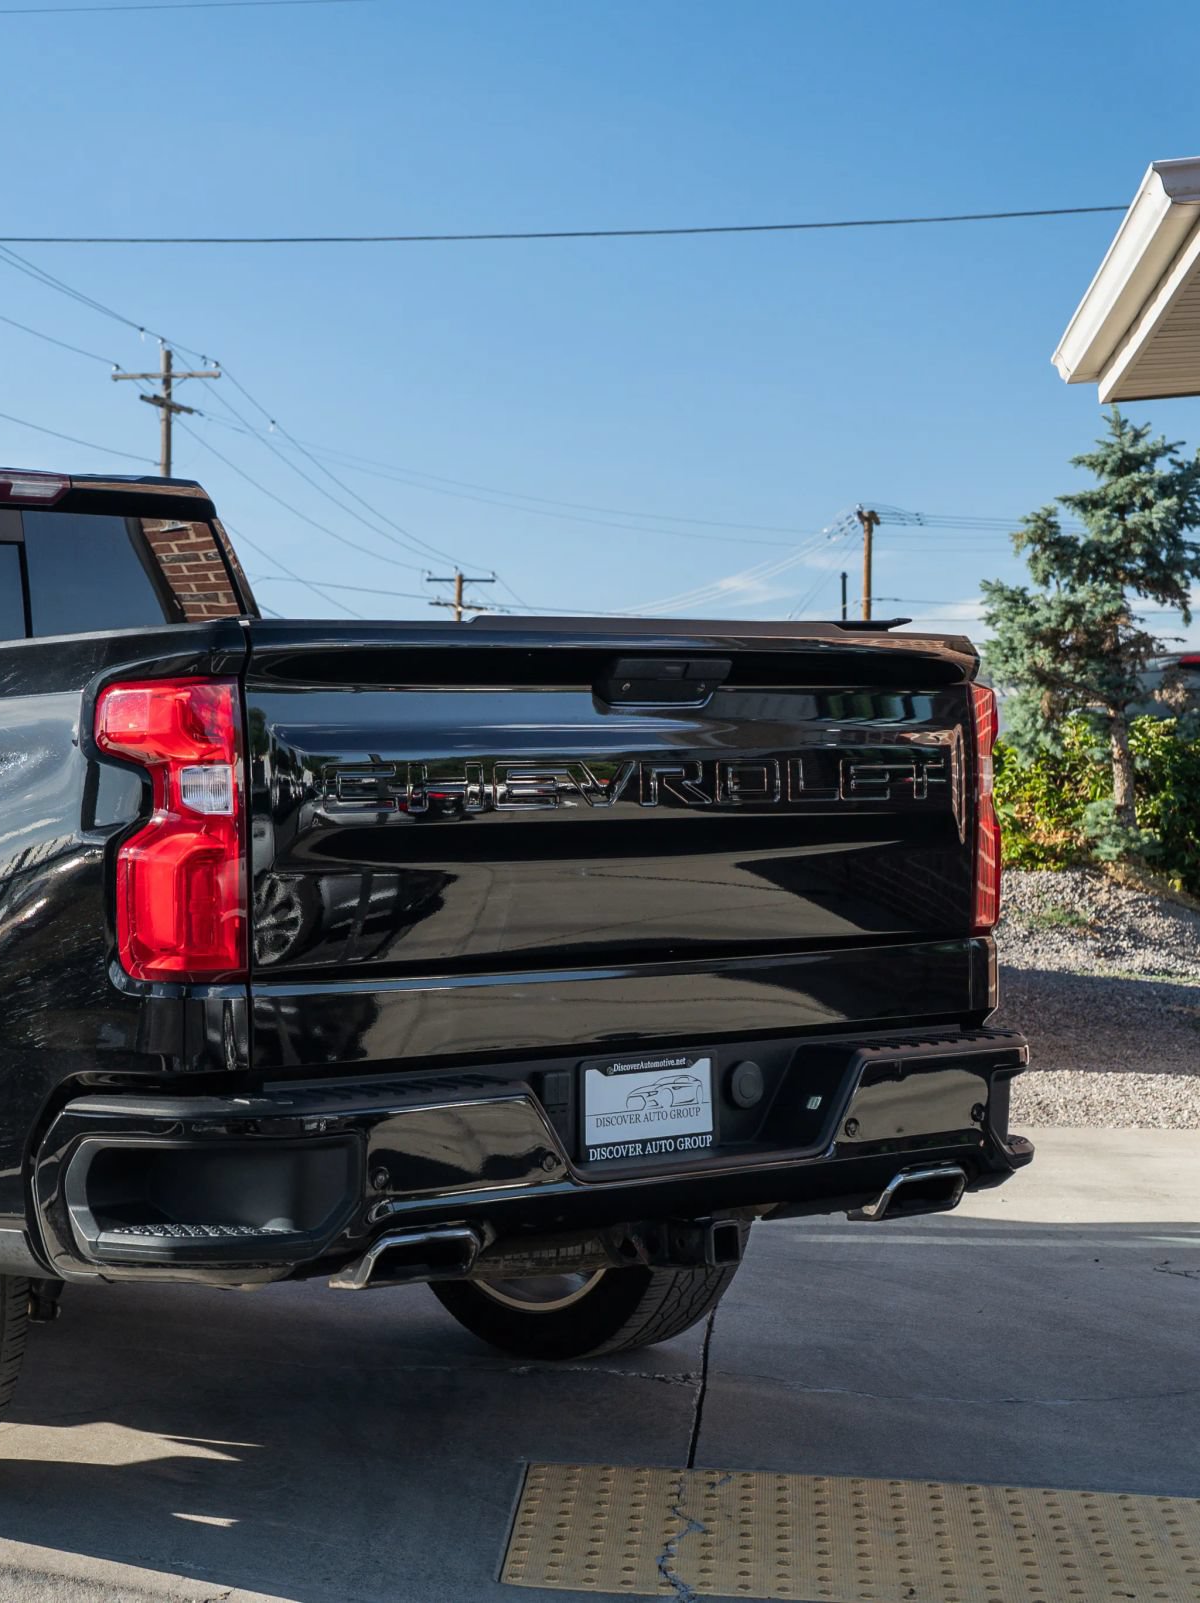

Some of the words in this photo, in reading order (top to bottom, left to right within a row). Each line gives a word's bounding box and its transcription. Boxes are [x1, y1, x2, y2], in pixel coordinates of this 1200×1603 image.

[322, 758, 946, 814] CHEVROLET
[613, 1057, 686, 1073] DiscoverAutomotive.net
[596, 1113, 641, 1128] DISCOVER
[643, 1110, 669, 1123] AUTO
[669, 1106, 701, 1120] GROUP
[589, 1142, 643, 1161] DISCOVER
[645, 1139, 675, 1155] AUTO
[676, 1134, 713, 1151] GROUP
